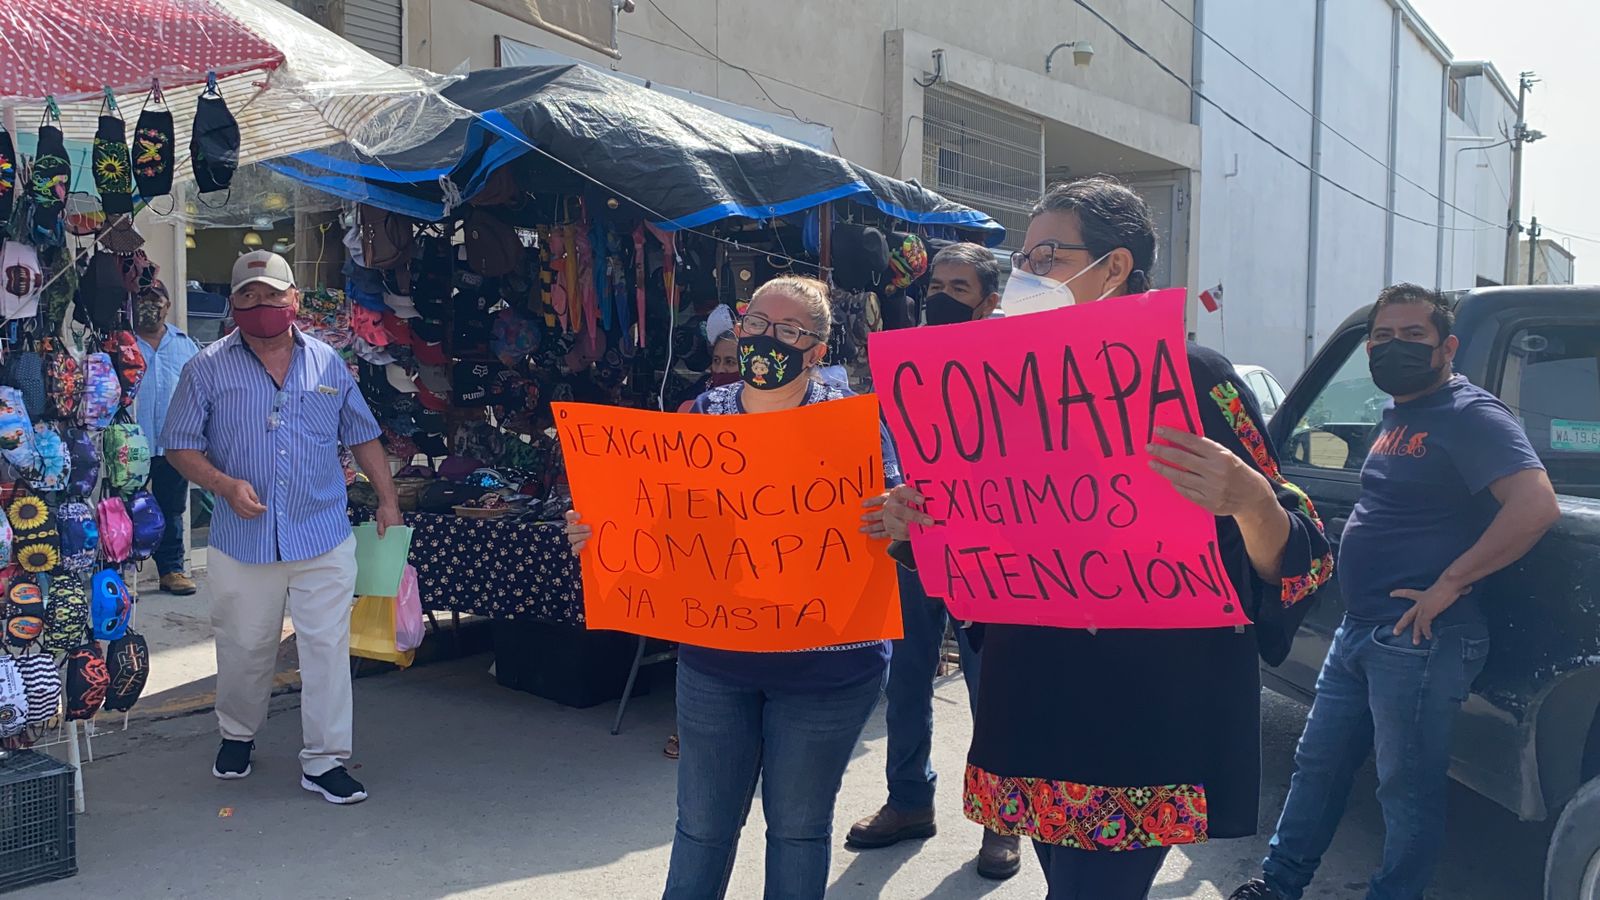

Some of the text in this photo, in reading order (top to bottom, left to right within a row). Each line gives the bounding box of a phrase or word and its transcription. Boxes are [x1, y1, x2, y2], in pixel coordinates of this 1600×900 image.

[893, 338, 1198, 465] COMAPA
[597, 520, 851, 581] COMAPA
[944, 540, 1234, 614] ATENCIÓN!
[618, 585, 827, 631] YA BASTA
